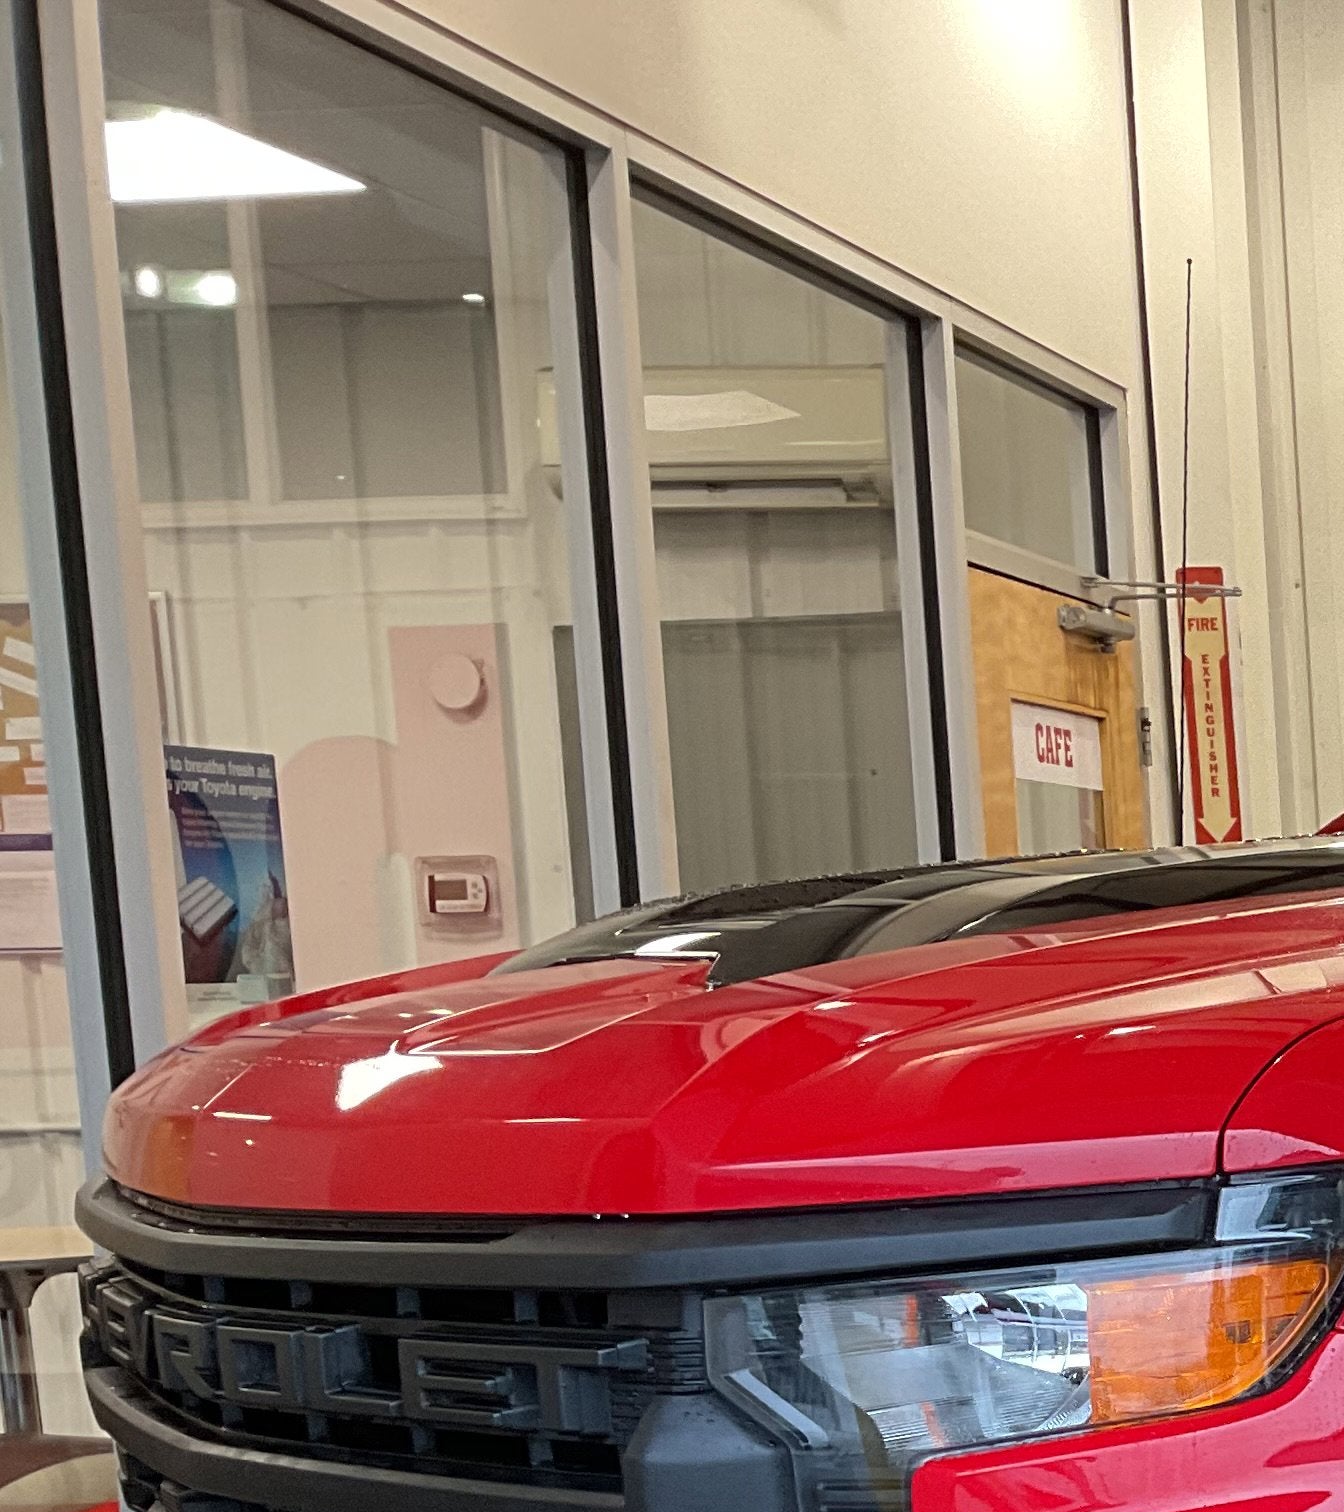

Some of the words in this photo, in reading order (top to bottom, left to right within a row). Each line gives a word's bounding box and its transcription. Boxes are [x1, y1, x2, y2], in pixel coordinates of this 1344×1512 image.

[1187, 616, 1219, 632] FIRE
[1200, 654, 1221, 798] EXTINGUISHER
[1034, 722, 1074, 768] CAFE
[184, 757, 226, 775] breathe
[228, 760, 255, 778] fresh
[173, 780, 199, 796] your
[200, 777, 237, 798] Toyota
